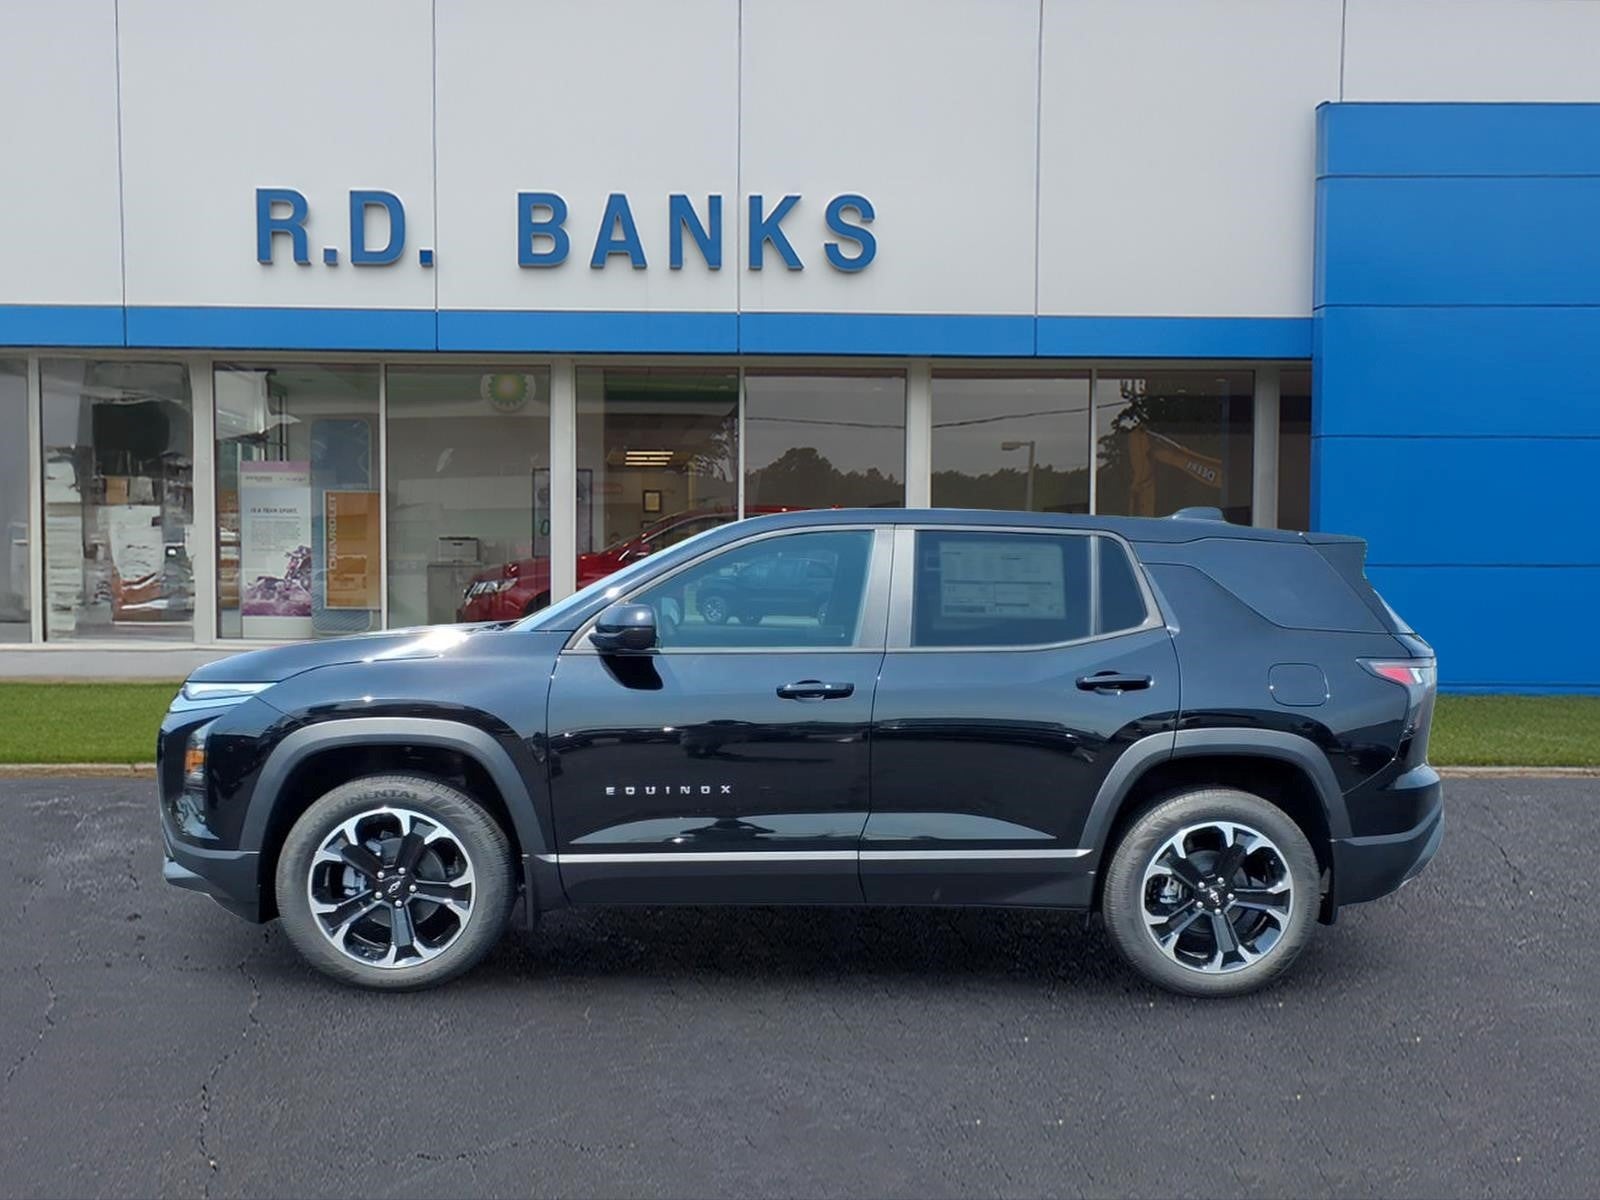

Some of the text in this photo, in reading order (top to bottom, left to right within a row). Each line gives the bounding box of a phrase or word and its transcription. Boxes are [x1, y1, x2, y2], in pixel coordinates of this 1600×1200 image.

[256, 187, 877, 273] R.D. BANKS
[605, 785, 732, 796] EQUINOX
